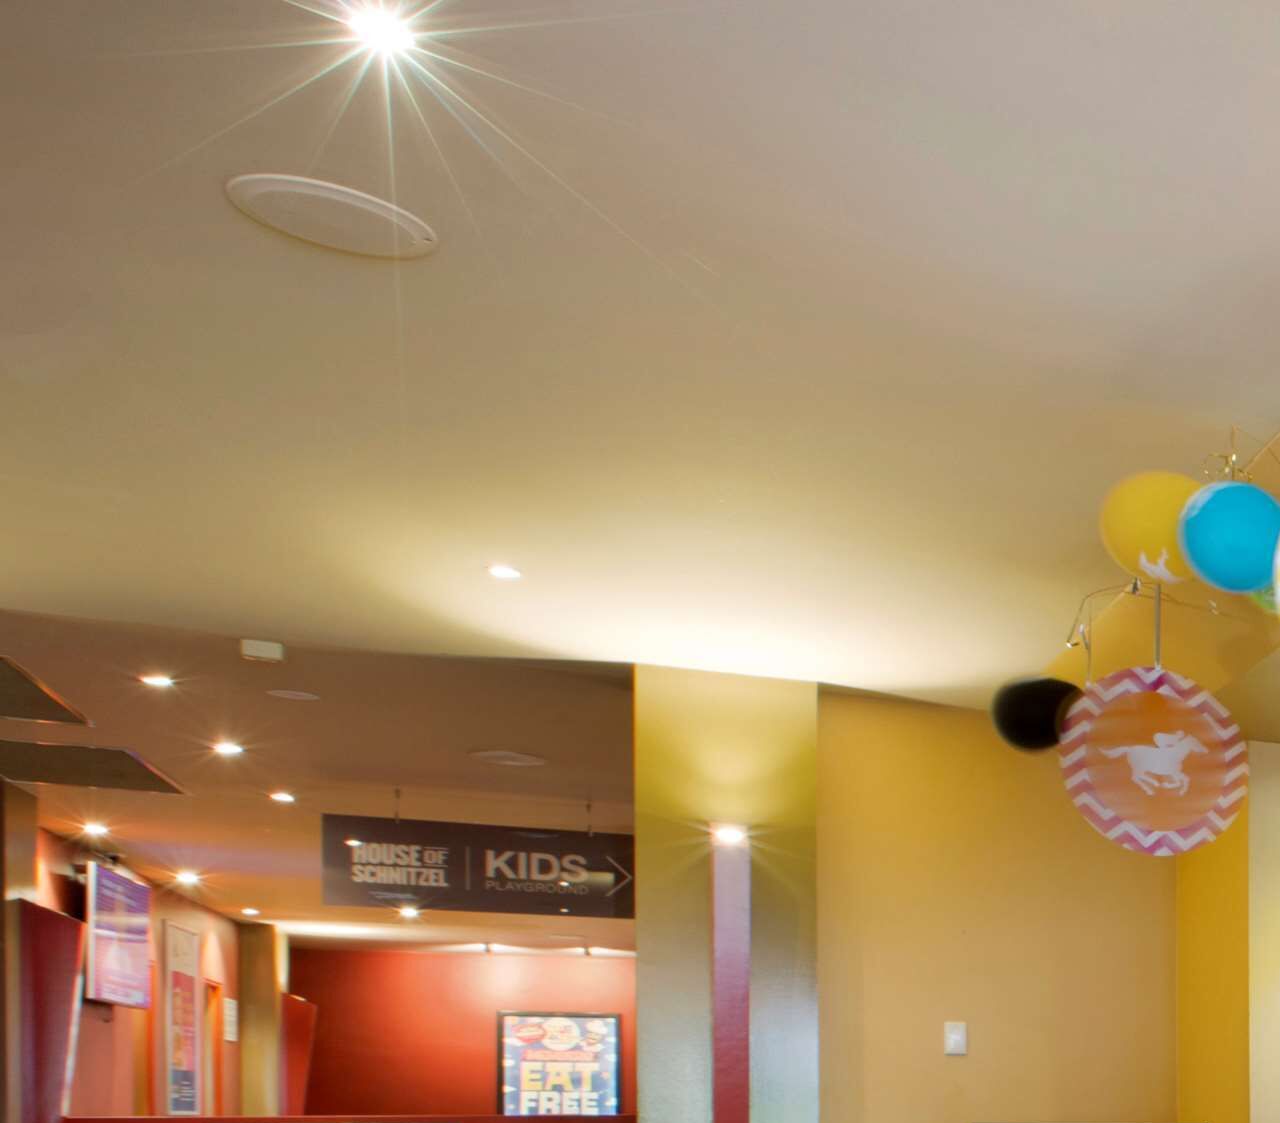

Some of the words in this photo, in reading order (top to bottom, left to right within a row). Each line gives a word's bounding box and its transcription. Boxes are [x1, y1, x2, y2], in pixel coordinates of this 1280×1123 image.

[353, 842, 421, 866] HOUSE
[424, 850, 448, 864] OF
[486, 850, 588, 882] KIDS
[352, 866, 449, 888] SCHNITZEL
[486, 880, 588, 895] PLAYGROUND
[521, 1061, 599, 1092] EAT
[521, 1091, 599, 1115] FREE
